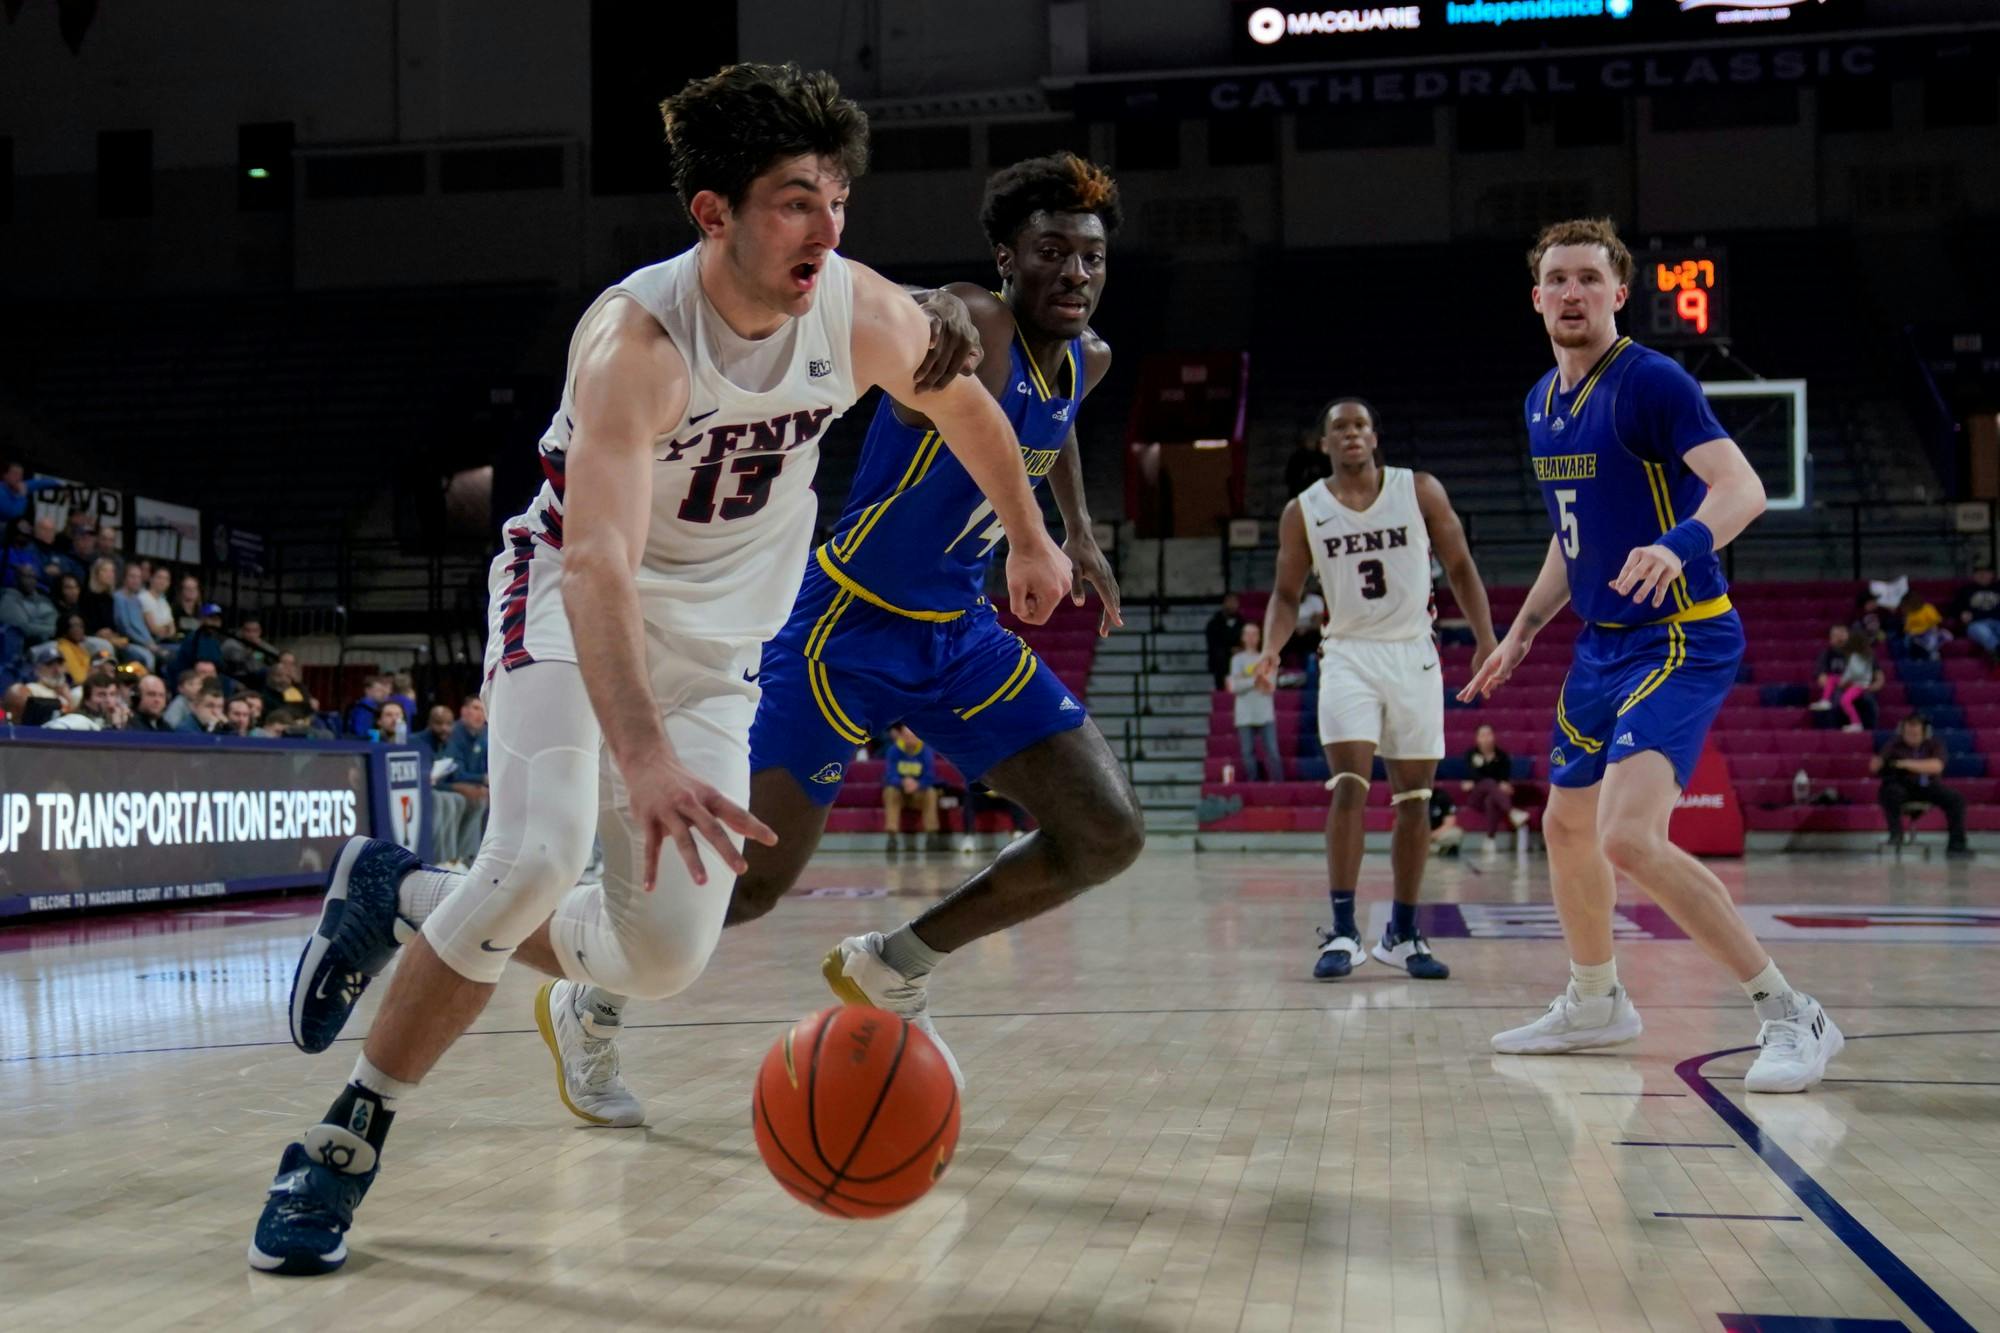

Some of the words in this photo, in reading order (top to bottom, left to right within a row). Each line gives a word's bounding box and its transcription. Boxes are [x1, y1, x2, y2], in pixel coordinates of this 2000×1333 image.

[1287, 6, 1420, 35] MACQUARIE
[1447, 0, 1602, 26] Independence
[1209, 64, 1576, 112] CATHEDRAL
[1601, 43, 1877, 90] CLASSIC
[1676, 289, 1709, 335] 9
[657, 406, 832, 463] PENN
[678, 454, 786, 523] 13
[1532, 453, 1597, 481] ELAWARE
[1323, 525, 1407, 558] PENN
[1554, 489, 1580, 559] 5
[1358, 559, 1387, 600] 3
[36, 790, 267, 851] TRANSPORTATION
[269, 789, 357, 838] EXPERTS
[29, 894, 71, 911] WELCOME
[74, 892, 87, 907] TO
[136, 887, 161, 902] COURT
[164, 885, 174, 898] AT
[176, 884, 190, 898] THE
